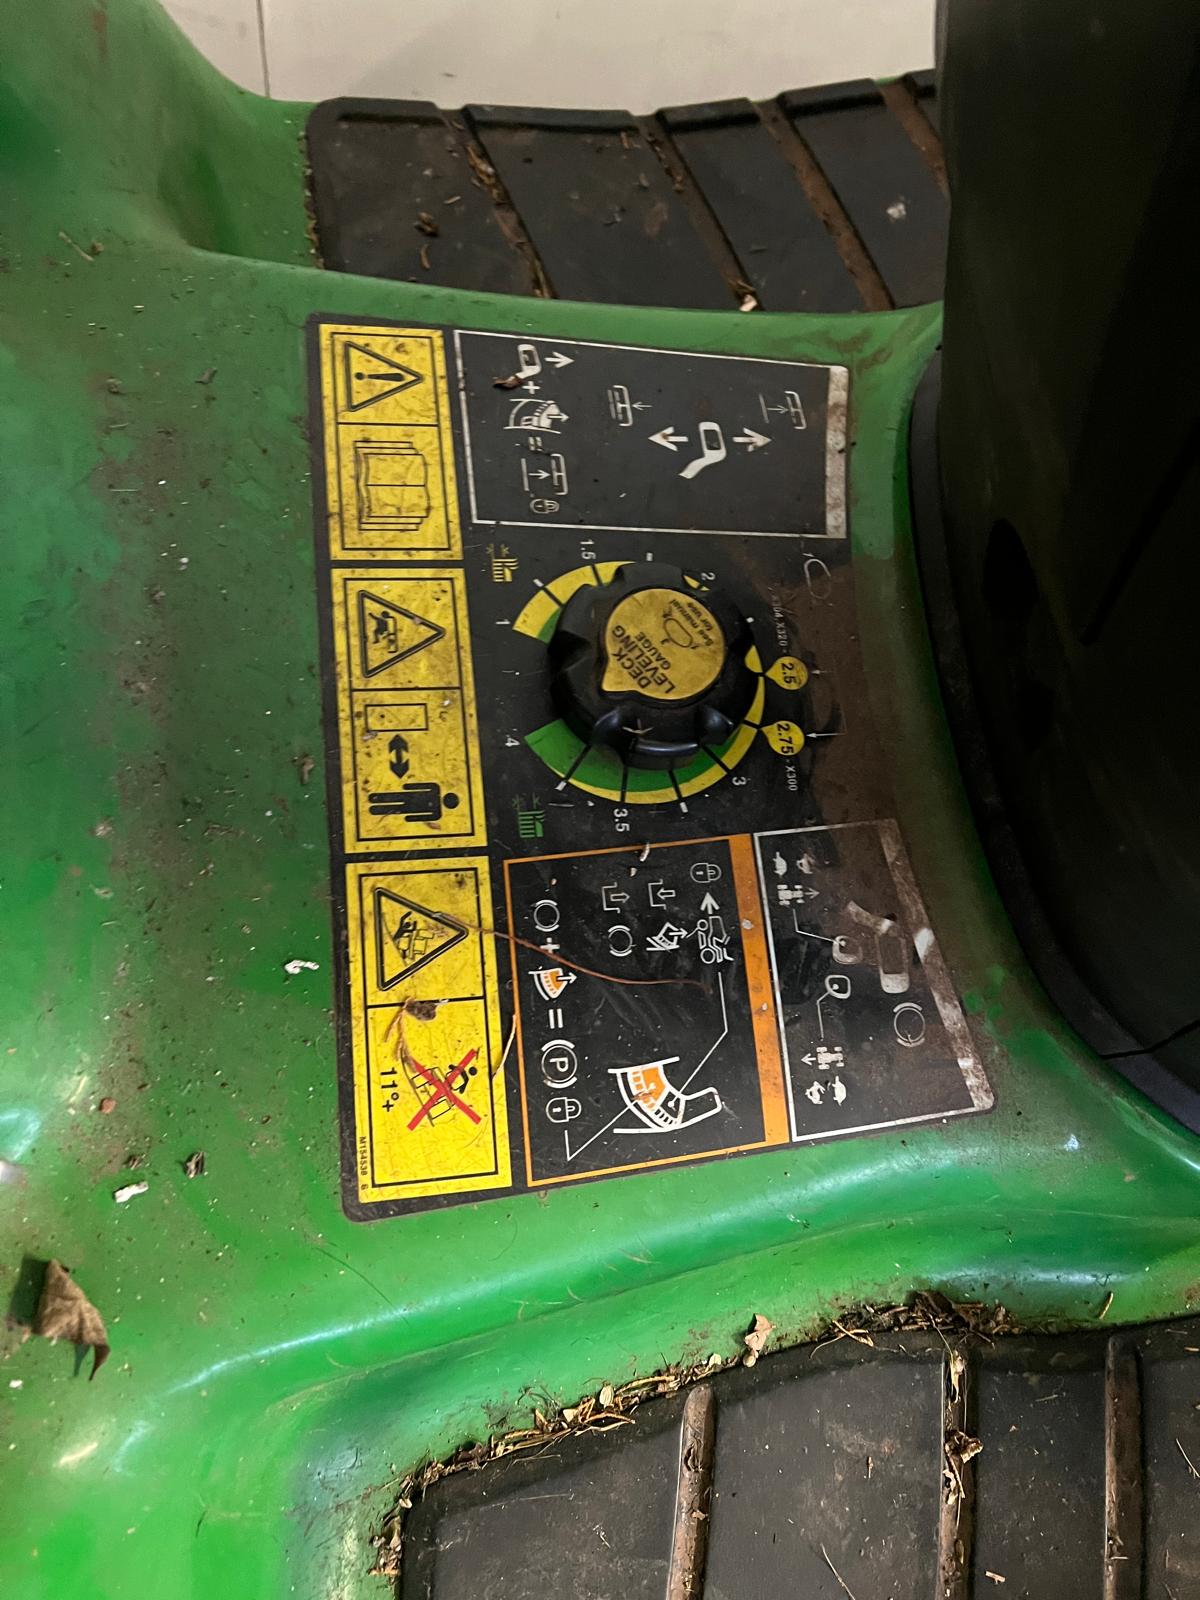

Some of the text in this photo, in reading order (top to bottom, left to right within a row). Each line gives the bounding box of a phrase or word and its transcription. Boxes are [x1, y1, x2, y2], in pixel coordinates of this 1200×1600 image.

[581, 540, 596, 559] 1.5
[703, 572, 715, 580] 2
[612, 625, 676, 694] LEVELING
[635, 632, 671, 670] GAUGE
[611, 648, 652, 689] DECK
[782, 663, 796, 684] 2.5
[505, 738, 519, 747] 4
[777, 724, 793, 754] 2.75
[733, 777, 745, 785] 3
[786, 766, 798, 791] X300
[615, 810, 629, 831] 3.5
